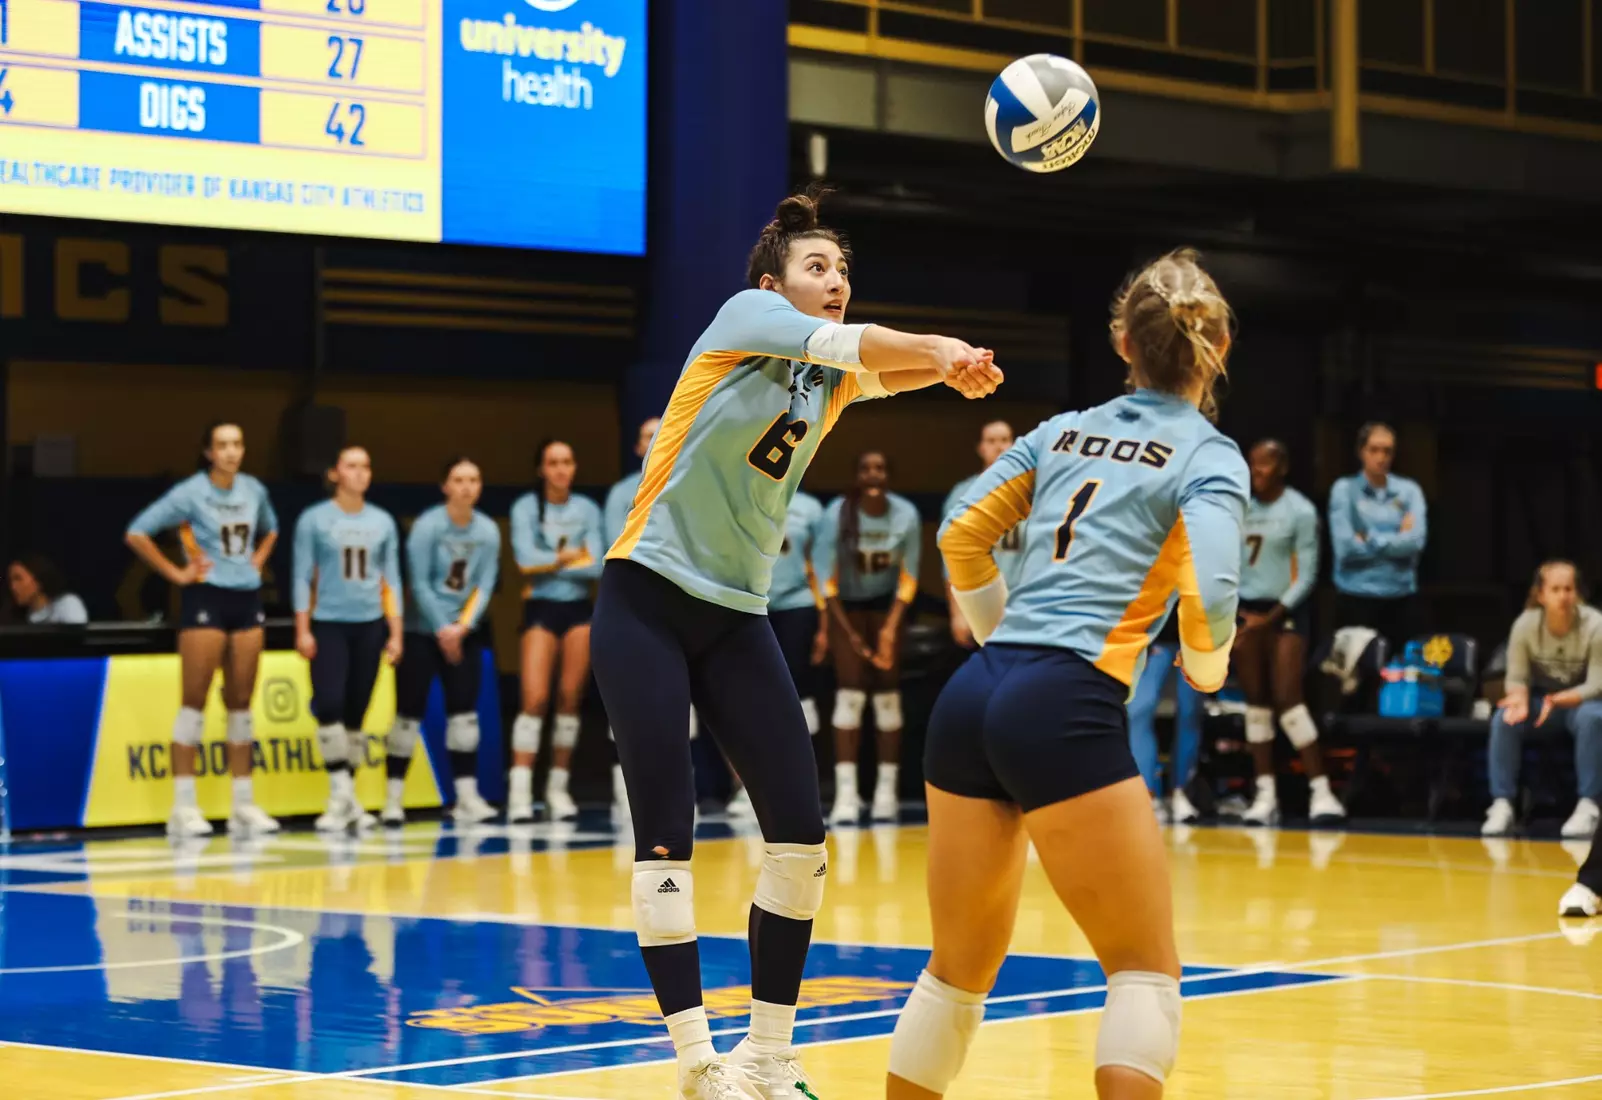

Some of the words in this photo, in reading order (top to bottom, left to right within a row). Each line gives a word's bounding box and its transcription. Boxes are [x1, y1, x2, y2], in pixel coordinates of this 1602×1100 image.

[114, 10, 228, 66] ASSISTS
[327, 35, 363, 80] 27
[460, 12, 627, 78] university
[139, 81, 206, 132] DIGS
[502, 58, 593, 110] health
[325, 101, 365, 146] 42
[109, 167, 196, 197] PROVIDER
[203, 175, 222, 199] OF
[229, 178, 294, 204] KANSAS
[301, 183, 335, 205] CITY
[746, 409, 810, 482] 6
[1051, 429, 1176, 470] ROOS
[220, 522, 251, 557] 17
[1053, 478, 1103, 563] 1
[342, 545, 370, 580] 11
[1244, 533, 1264, 567] 7
[657, 886, 680, 894] adidas
